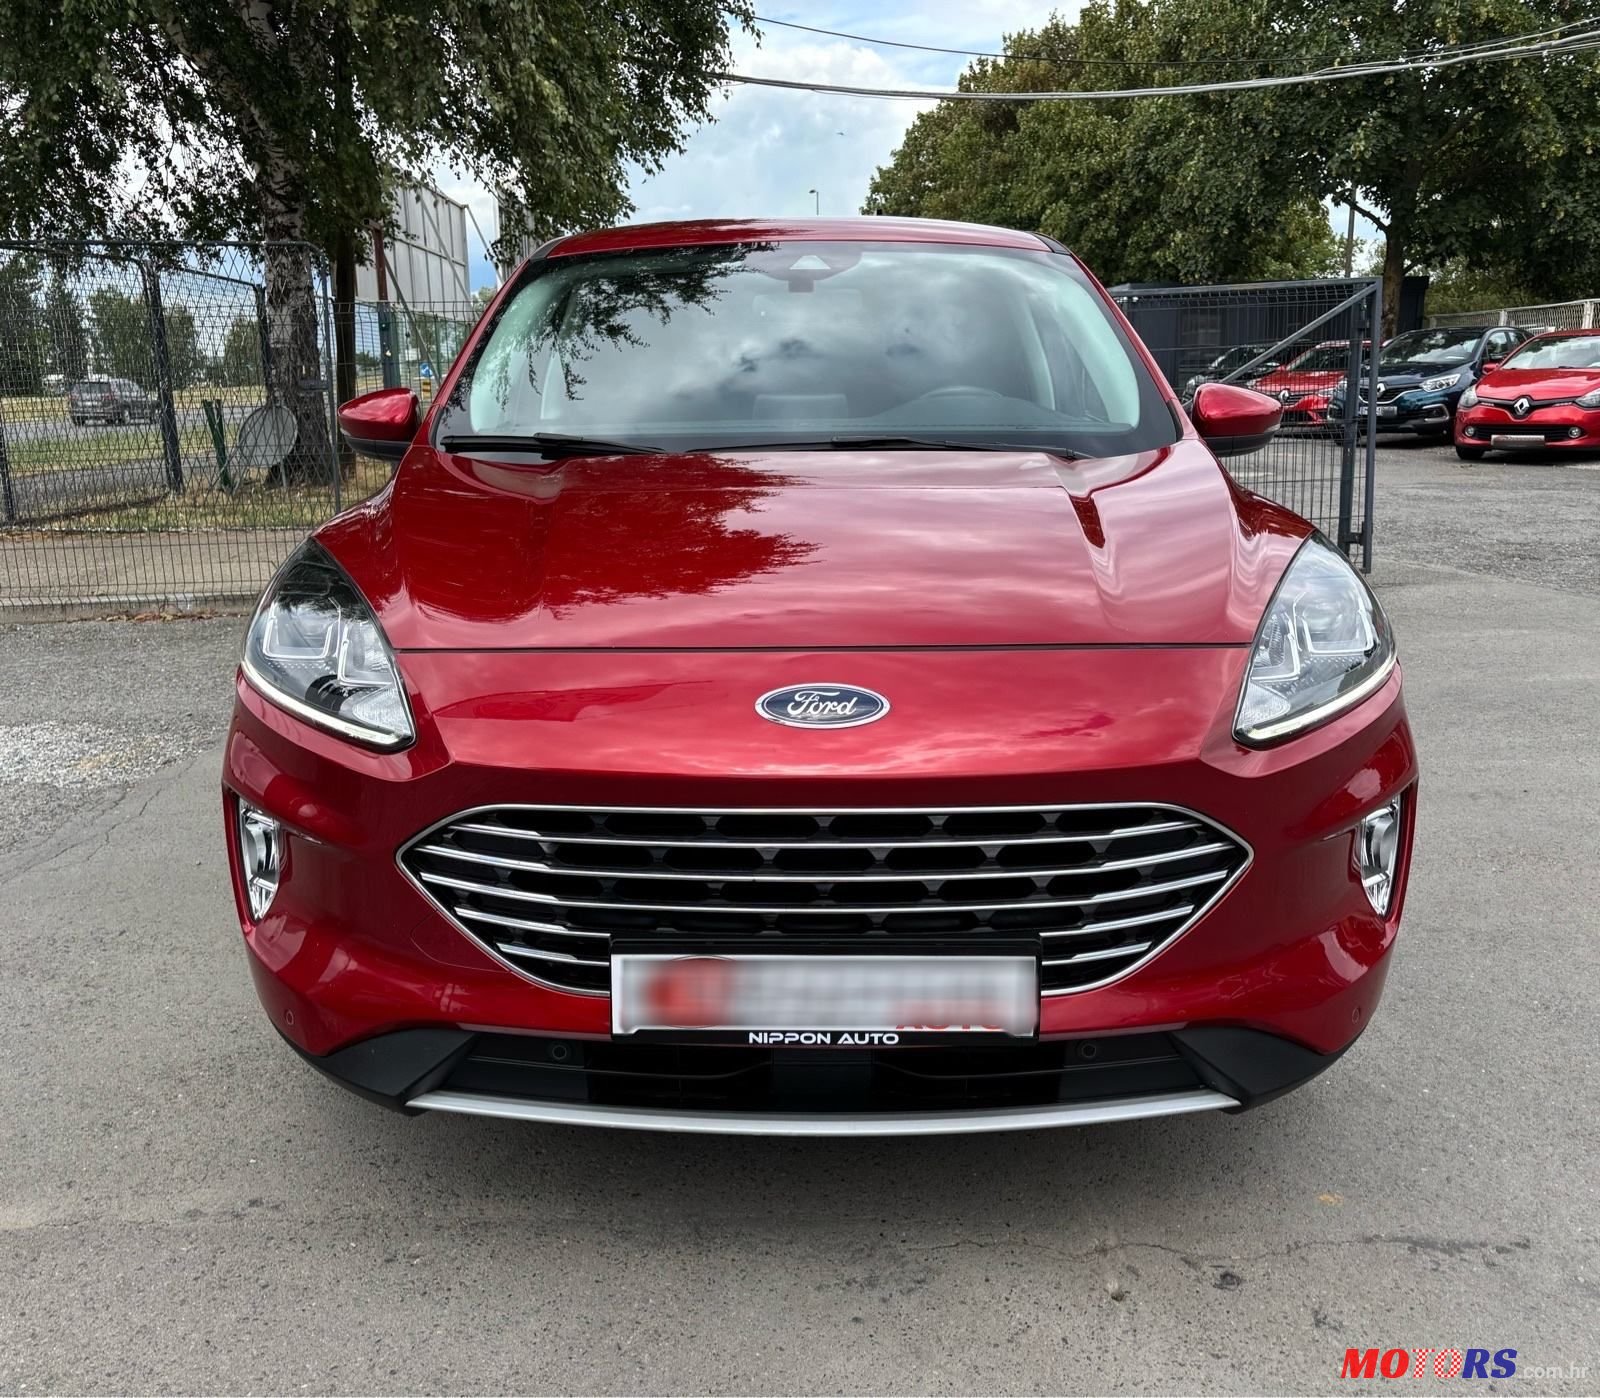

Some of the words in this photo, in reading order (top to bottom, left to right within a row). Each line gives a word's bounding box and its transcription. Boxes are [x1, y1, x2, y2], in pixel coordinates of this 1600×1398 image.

[787, 690, 858, 715] Ford
[748, 1032, 831, 1044] NIPPON
[837, 1032, 899, 1045] AUTO
